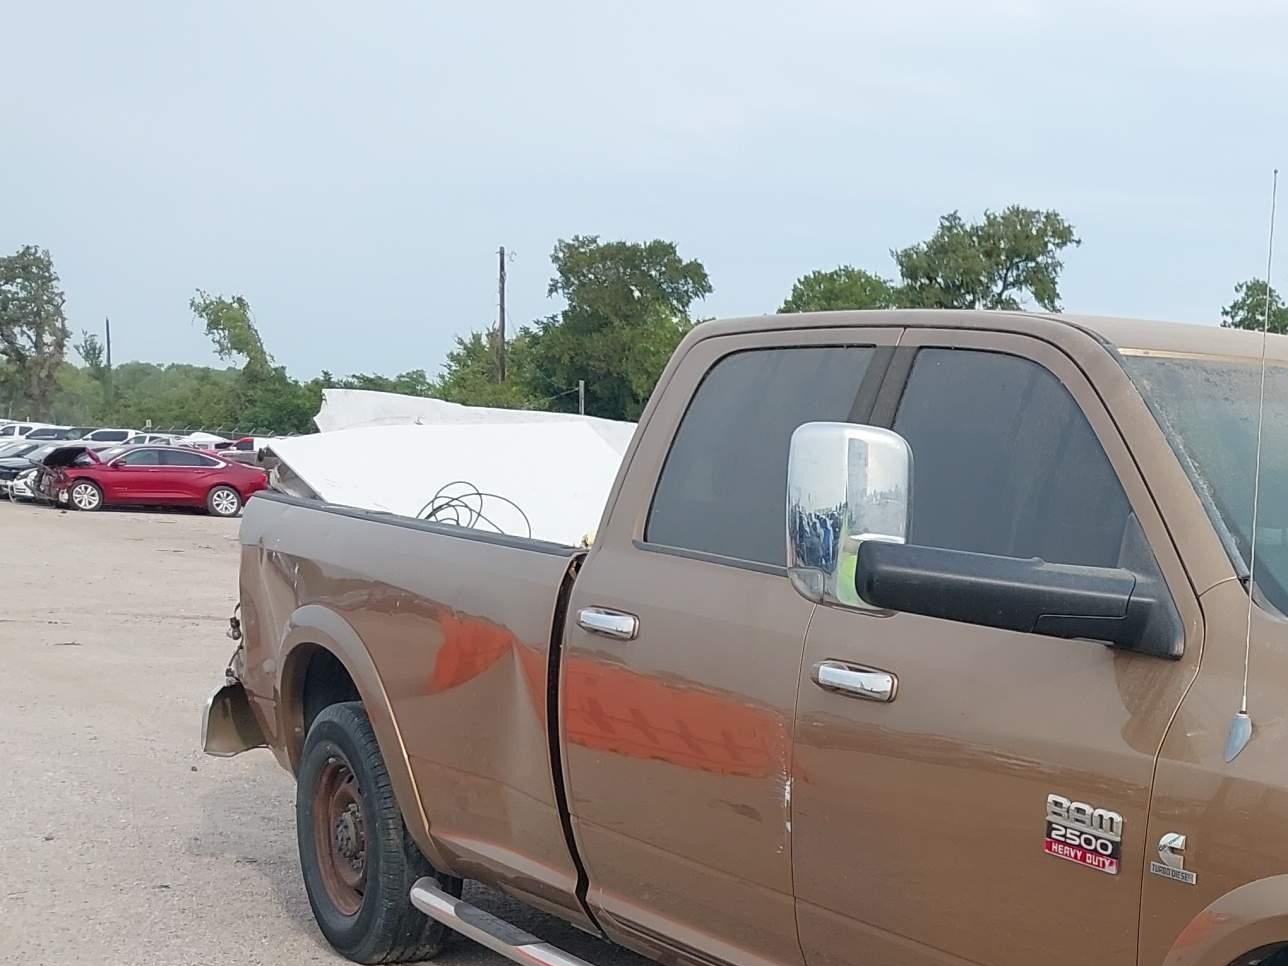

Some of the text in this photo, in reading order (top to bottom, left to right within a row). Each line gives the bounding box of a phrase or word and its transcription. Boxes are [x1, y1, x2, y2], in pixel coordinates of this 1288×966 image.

[1047, 793, 1123, 836] RAM
[1051, 824, 1113, 855] 2500
[1051, 843, 1111, 869] HEAVY DUTY
[1152, 863, 1171, 876] TURBO
